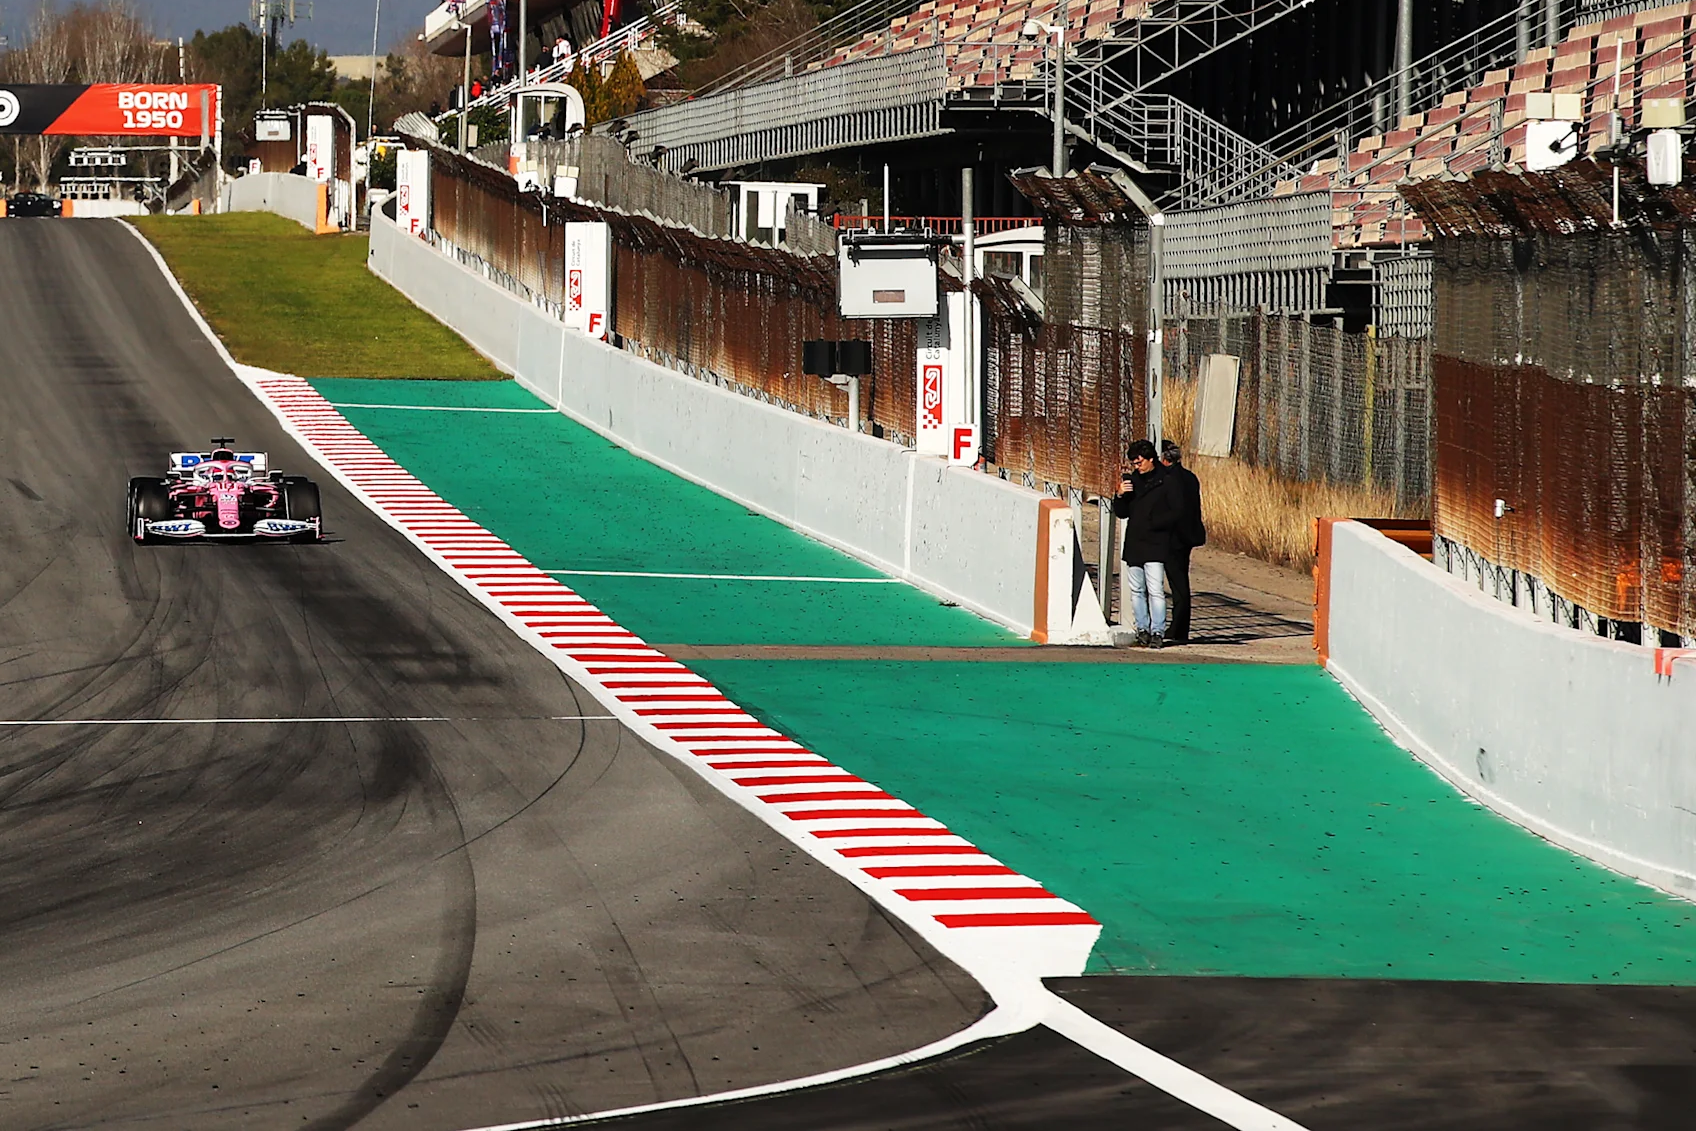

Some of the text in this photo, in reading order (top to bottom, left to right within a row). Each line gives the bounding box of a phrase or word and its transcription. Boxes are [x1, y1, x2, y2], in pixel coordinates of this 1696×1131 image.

[118, 91, 188, 110] BORN
[122, 110, 184, 129] 1950
[317, 167, 325, 179] F
[410, 218, 420, 233] F
[588, 312, 603, 333] F
[925, 332, 933, 360] Circuit
[953, 427, 973, 460] F
